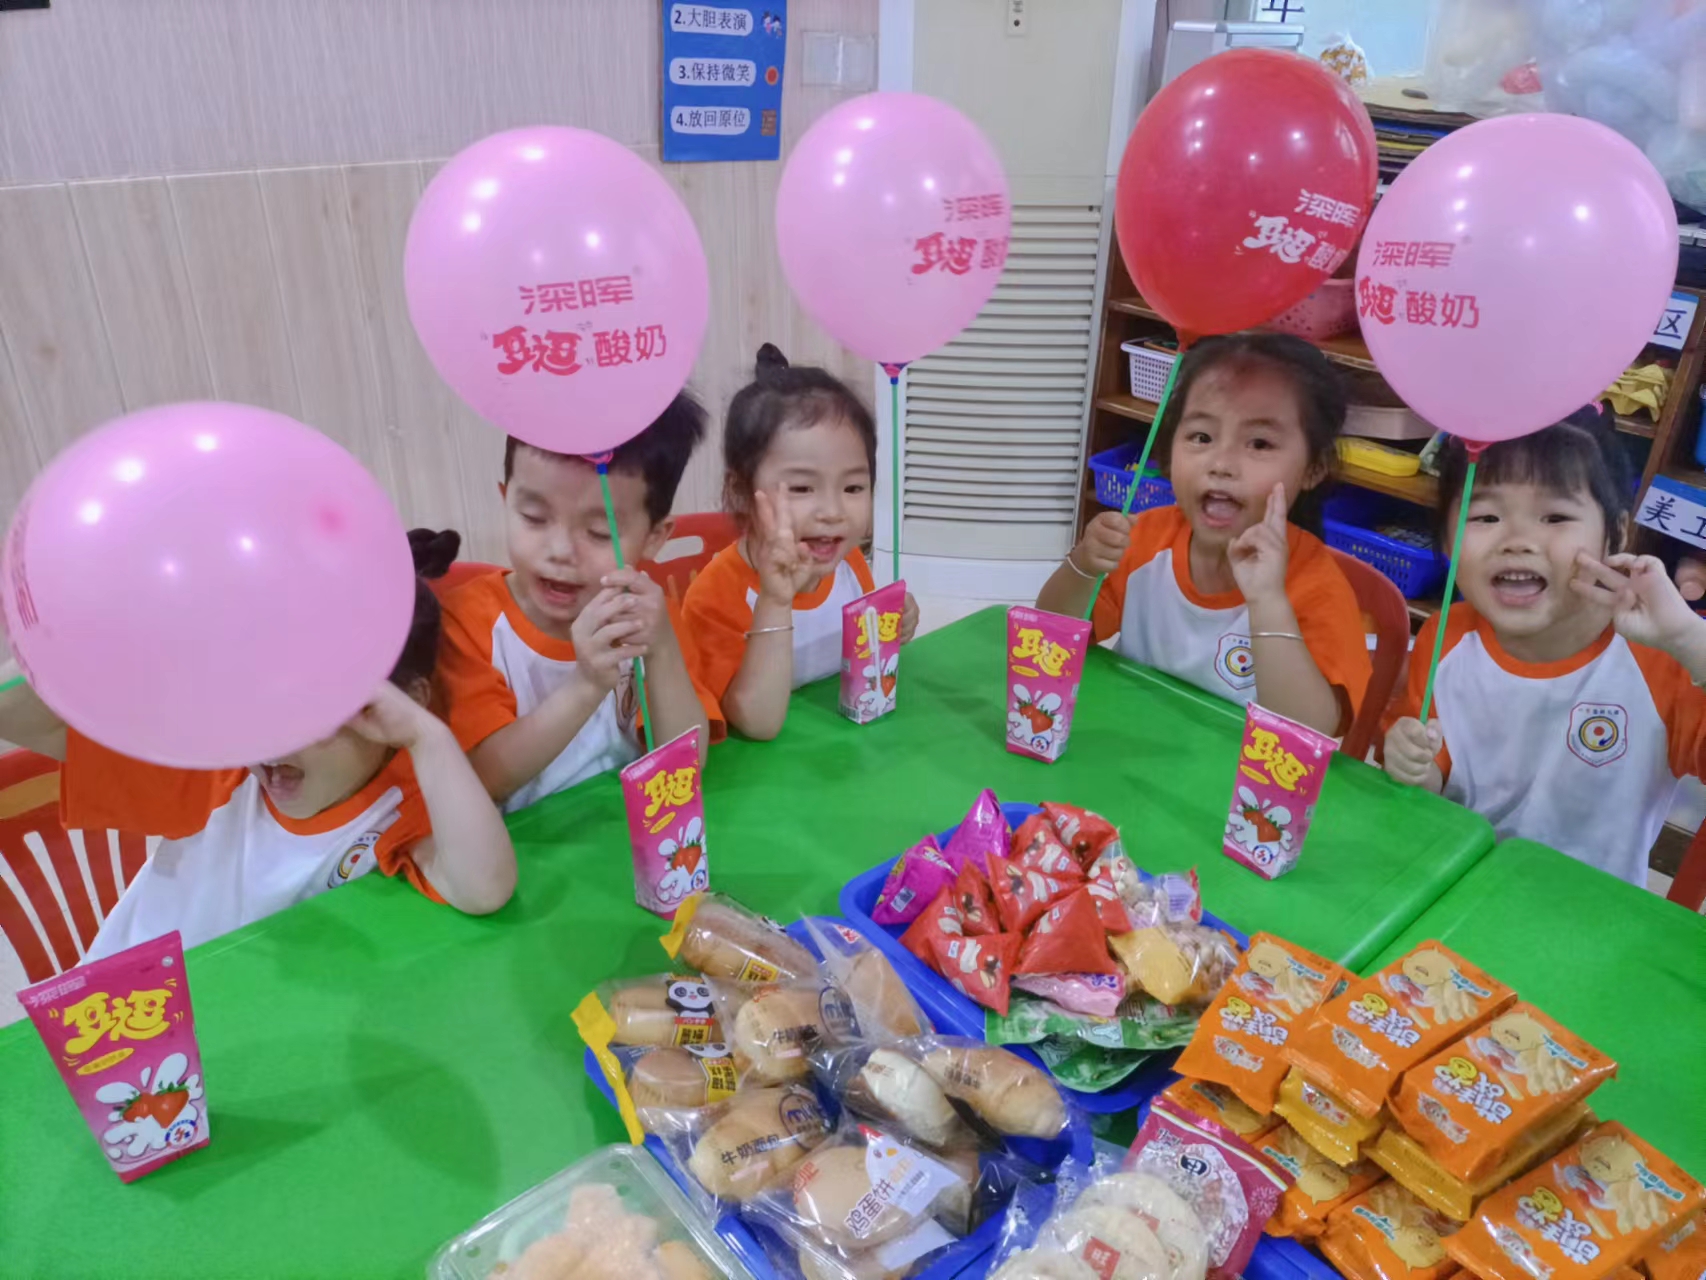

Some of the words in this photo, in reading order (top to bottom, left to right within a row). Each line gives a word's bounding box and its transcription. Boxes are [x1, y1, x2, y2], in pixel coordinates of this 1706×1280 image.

[674, 10, 747, 31] 2.大胆表演
[678, 63, 750, 82] 3.保持微笑
[675, 110, 746, 129] 4.放回原位
[1373, 241, 1455, 268] 深晖
[518, 275, 634, 315] 深晖
[843, 1177, 896, 1238] 鸡蛋饼
